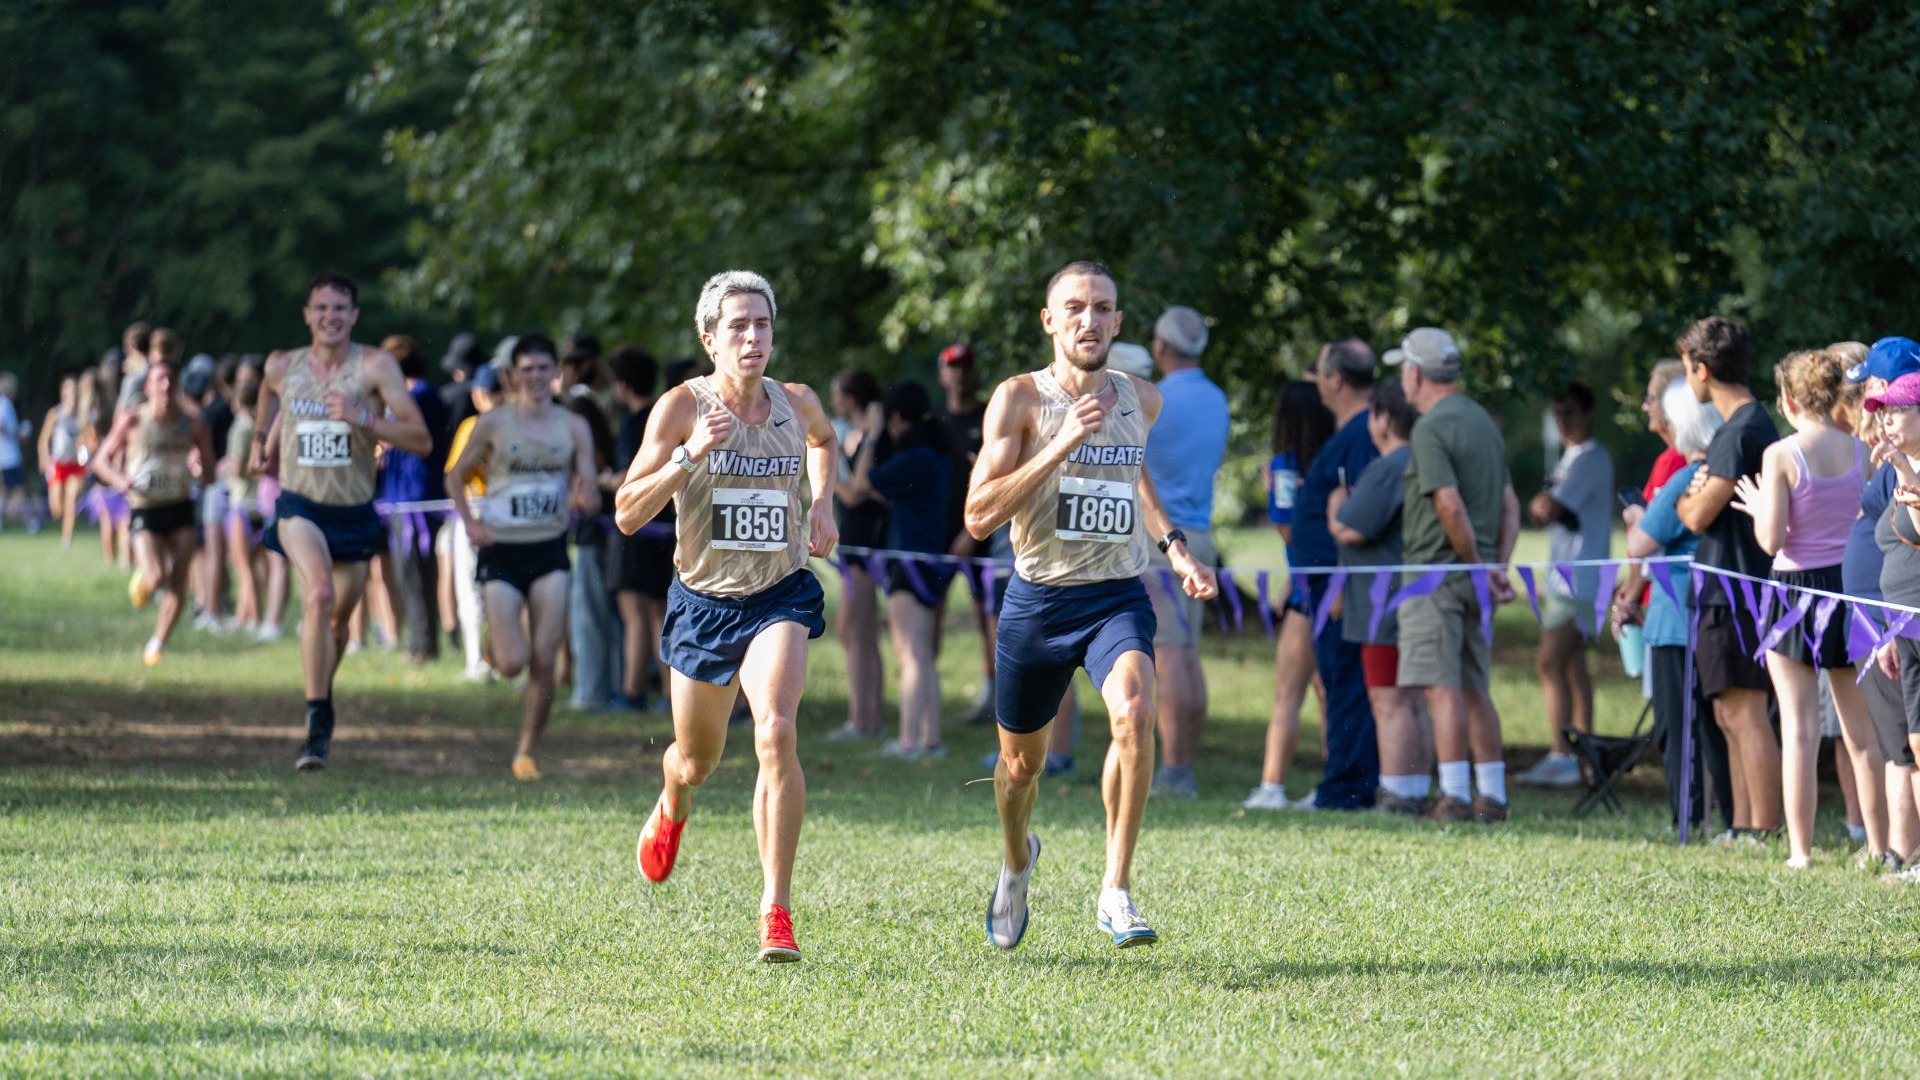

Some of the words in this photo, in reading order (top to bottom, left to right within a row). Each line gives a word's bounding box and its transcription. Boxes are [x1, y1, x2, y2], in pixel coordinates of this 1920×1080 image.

[301, 433, 350, 459] 1854
[708, 449, 801, 477] WINGATE
[720, 506, 785, 541] 1859
[1066, 495, 1132, 534] 1860
